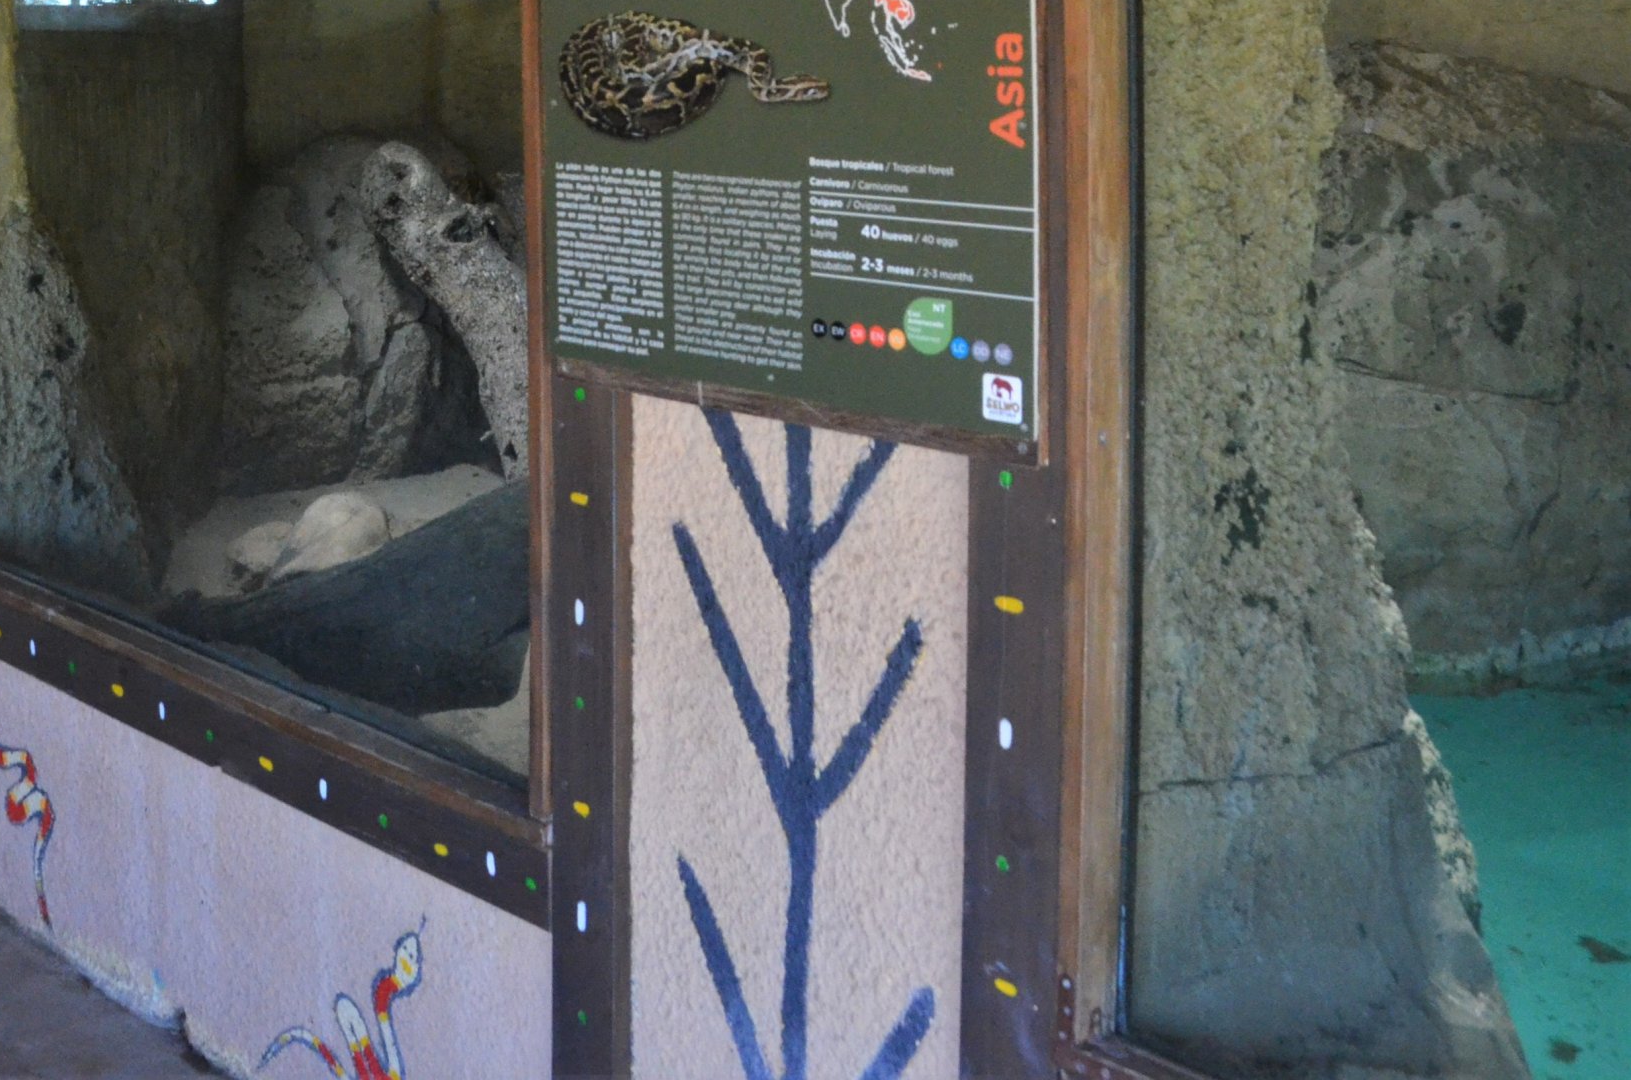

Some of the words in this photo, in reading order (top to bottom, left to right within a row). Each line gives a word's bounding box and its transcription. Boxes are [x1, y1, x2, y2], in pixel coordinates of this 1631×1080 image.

[987, 32, 1026, 149] Asia
[809, 157, 840, 169] Bosque
[893, 162, 926, 174] Tropical
[929, 165, 954, 176] forest
[858, 181, 908, 193] Carnivorous
[853, 200, 896, 212] Oviparous
[861, 225, 880, 239] 40
[882, 230, 913, 242] huevos
[922, 235, 934, 245] 40
[936, 237, 958, 248] eggs
[861, 257, 884, 272] 2-3
[887, 264, 914, 276] meses
[924, 267, 938, 279] 2-3
[940, 271, 974, 283] months
[932, 303, 946, 314] NT
[813, 323, 825, 333] EX
[831, 326, 846, 337] EW
[951, 342, 966, 354] LC
